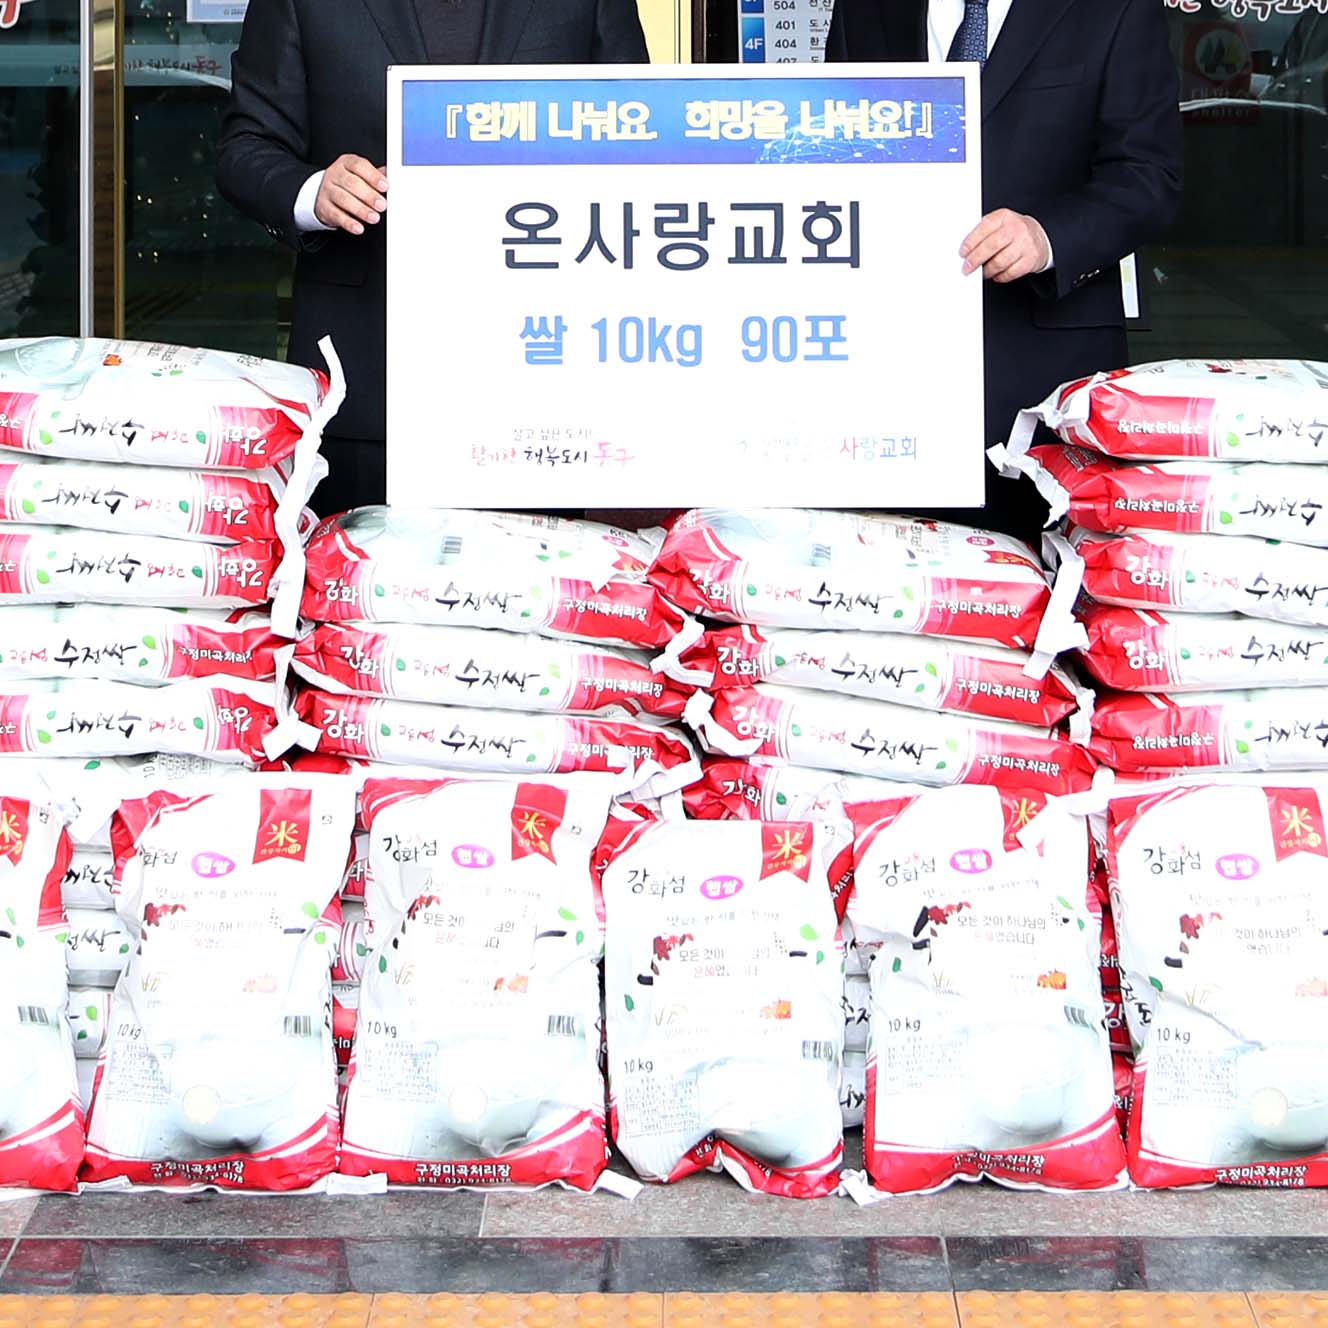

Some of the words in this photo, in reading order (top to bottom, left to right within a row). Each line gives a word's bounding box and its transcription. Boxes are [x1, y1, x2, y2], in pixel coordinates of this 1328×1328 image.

[774, 2, 796, 10] 504
[776, 21, 795, 30] 401
[745, 38, 762, 49] 4F
[775, 40, 796, 48] 404
[685, 100, 786, 142] 희망을
[502, 199, 861, 271] 온사랑교회
[520, 315, 567, 366] 쌀
[592, 316, 704, 367] 10kg
[741, 314, 850, 364] 90포
[522, 444, 589, 465] 행복도시
[593, 441, 635, 466] 동구
[1125, 557, 1169, 591] 강화
[808, 581, 895, 614] 수정쌀
[935, 601, 1021, 618] 구정미곡처리장
[54, 639, 137, 668] 수정쌀
[1125, 638, 1168, 672] 강화
[1240, 635, 1324, 665] 수정쌀
[717, 646, 759, 677] 강화
[831, 652, 918, 683] 수정쌀
[956, 679, 1040, 704] 구정미곡처리장
[733, 705, 774, 742] 강화
[850, 728, 939, 764] 수정쌀
[978, 753, 1061, 776] 구정미곡처리장
[272, 820, 299, 848] 米
[1280, 806, 1314, 836] 米
[383, 835, 438, 863] 강화섬
[773, 829, 804, 858] 米
[879, 858, 937, 888] 강화섬
[1143, 846, 1203, 877] 강화섬
[627, 868, 687, 900] 강화섬
[1156, 1028, 1171, 1042] 10
[1173, 1027, 1191, 1044] kg
[415, 1162, 511, 1178] 구정미곡처리장
